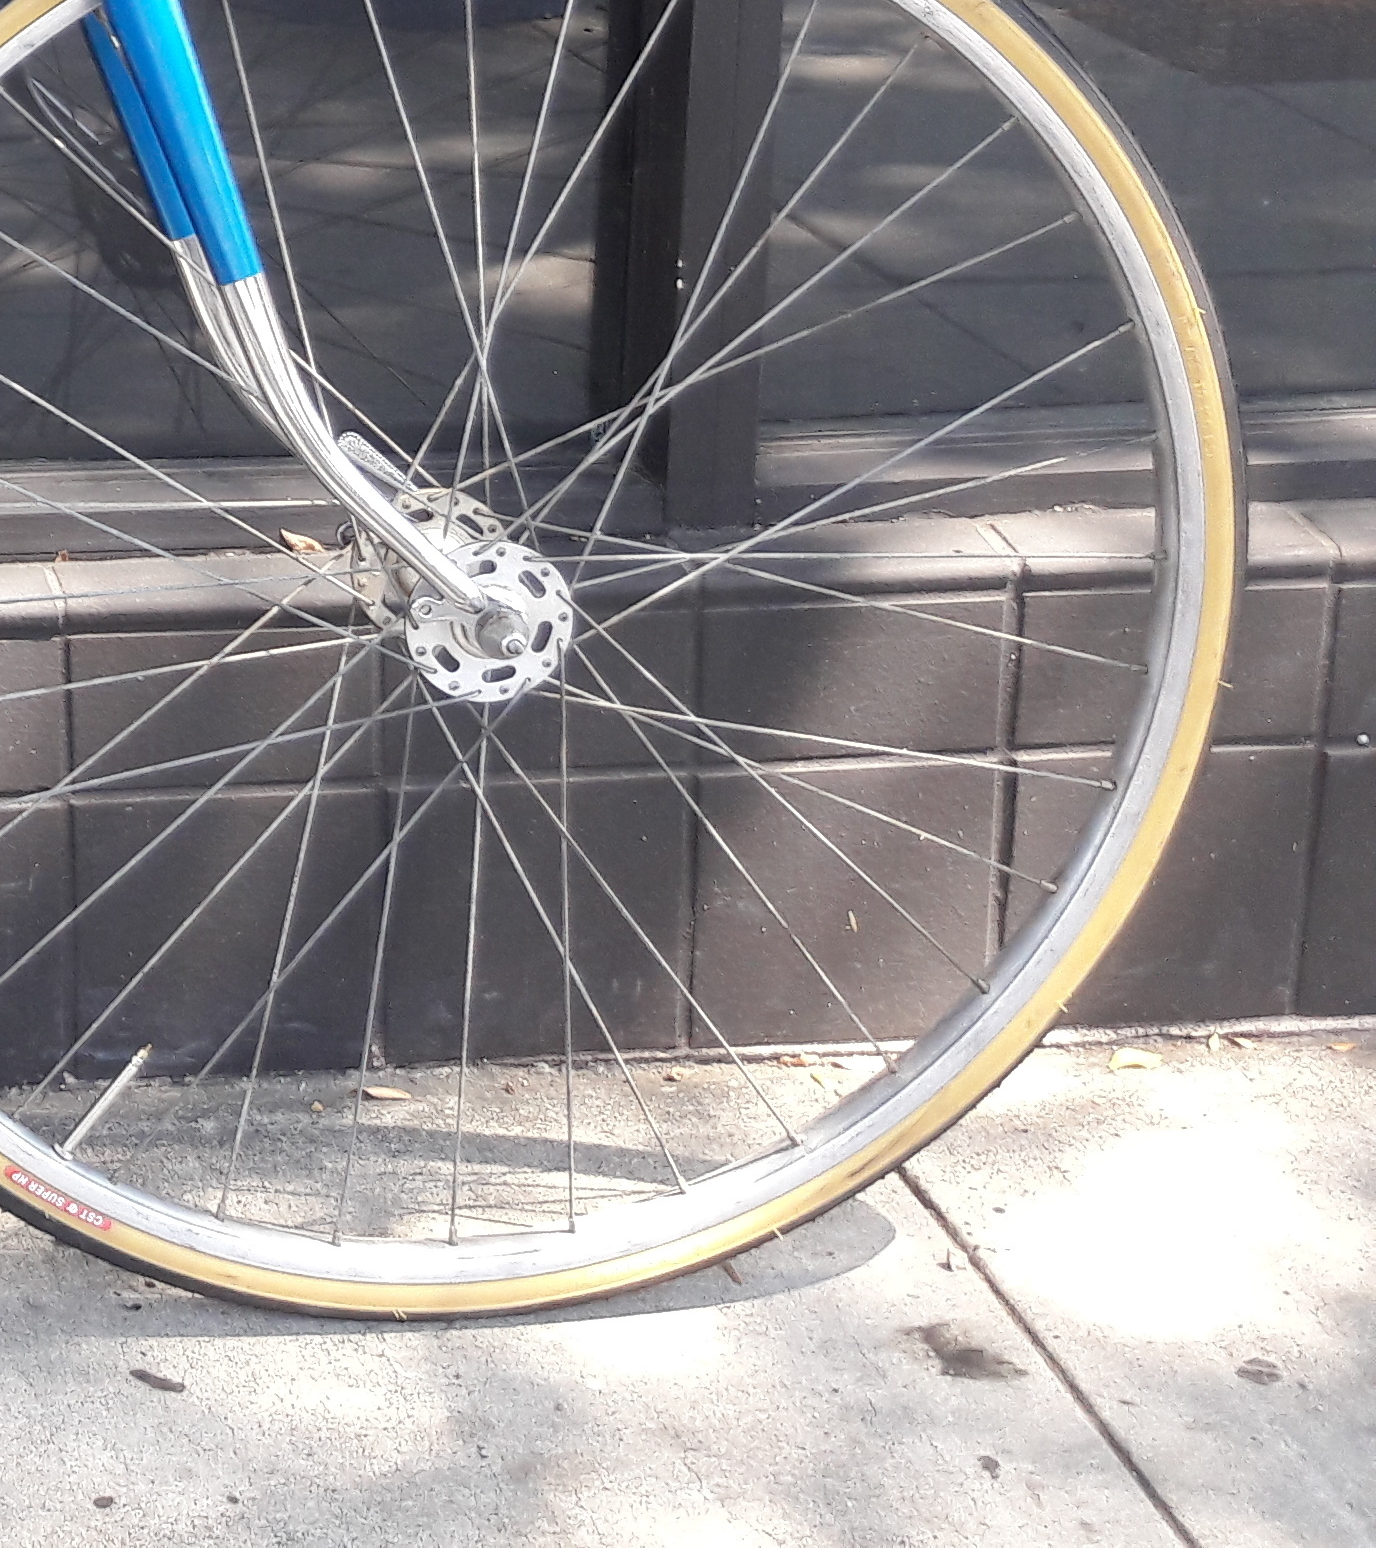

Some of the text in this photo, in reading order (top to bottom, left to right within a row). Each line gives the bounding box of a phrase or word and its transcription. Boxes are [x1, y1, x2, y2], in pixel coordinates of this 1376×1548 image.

[11, 1172, 104, 1226] CST SUPER HP
